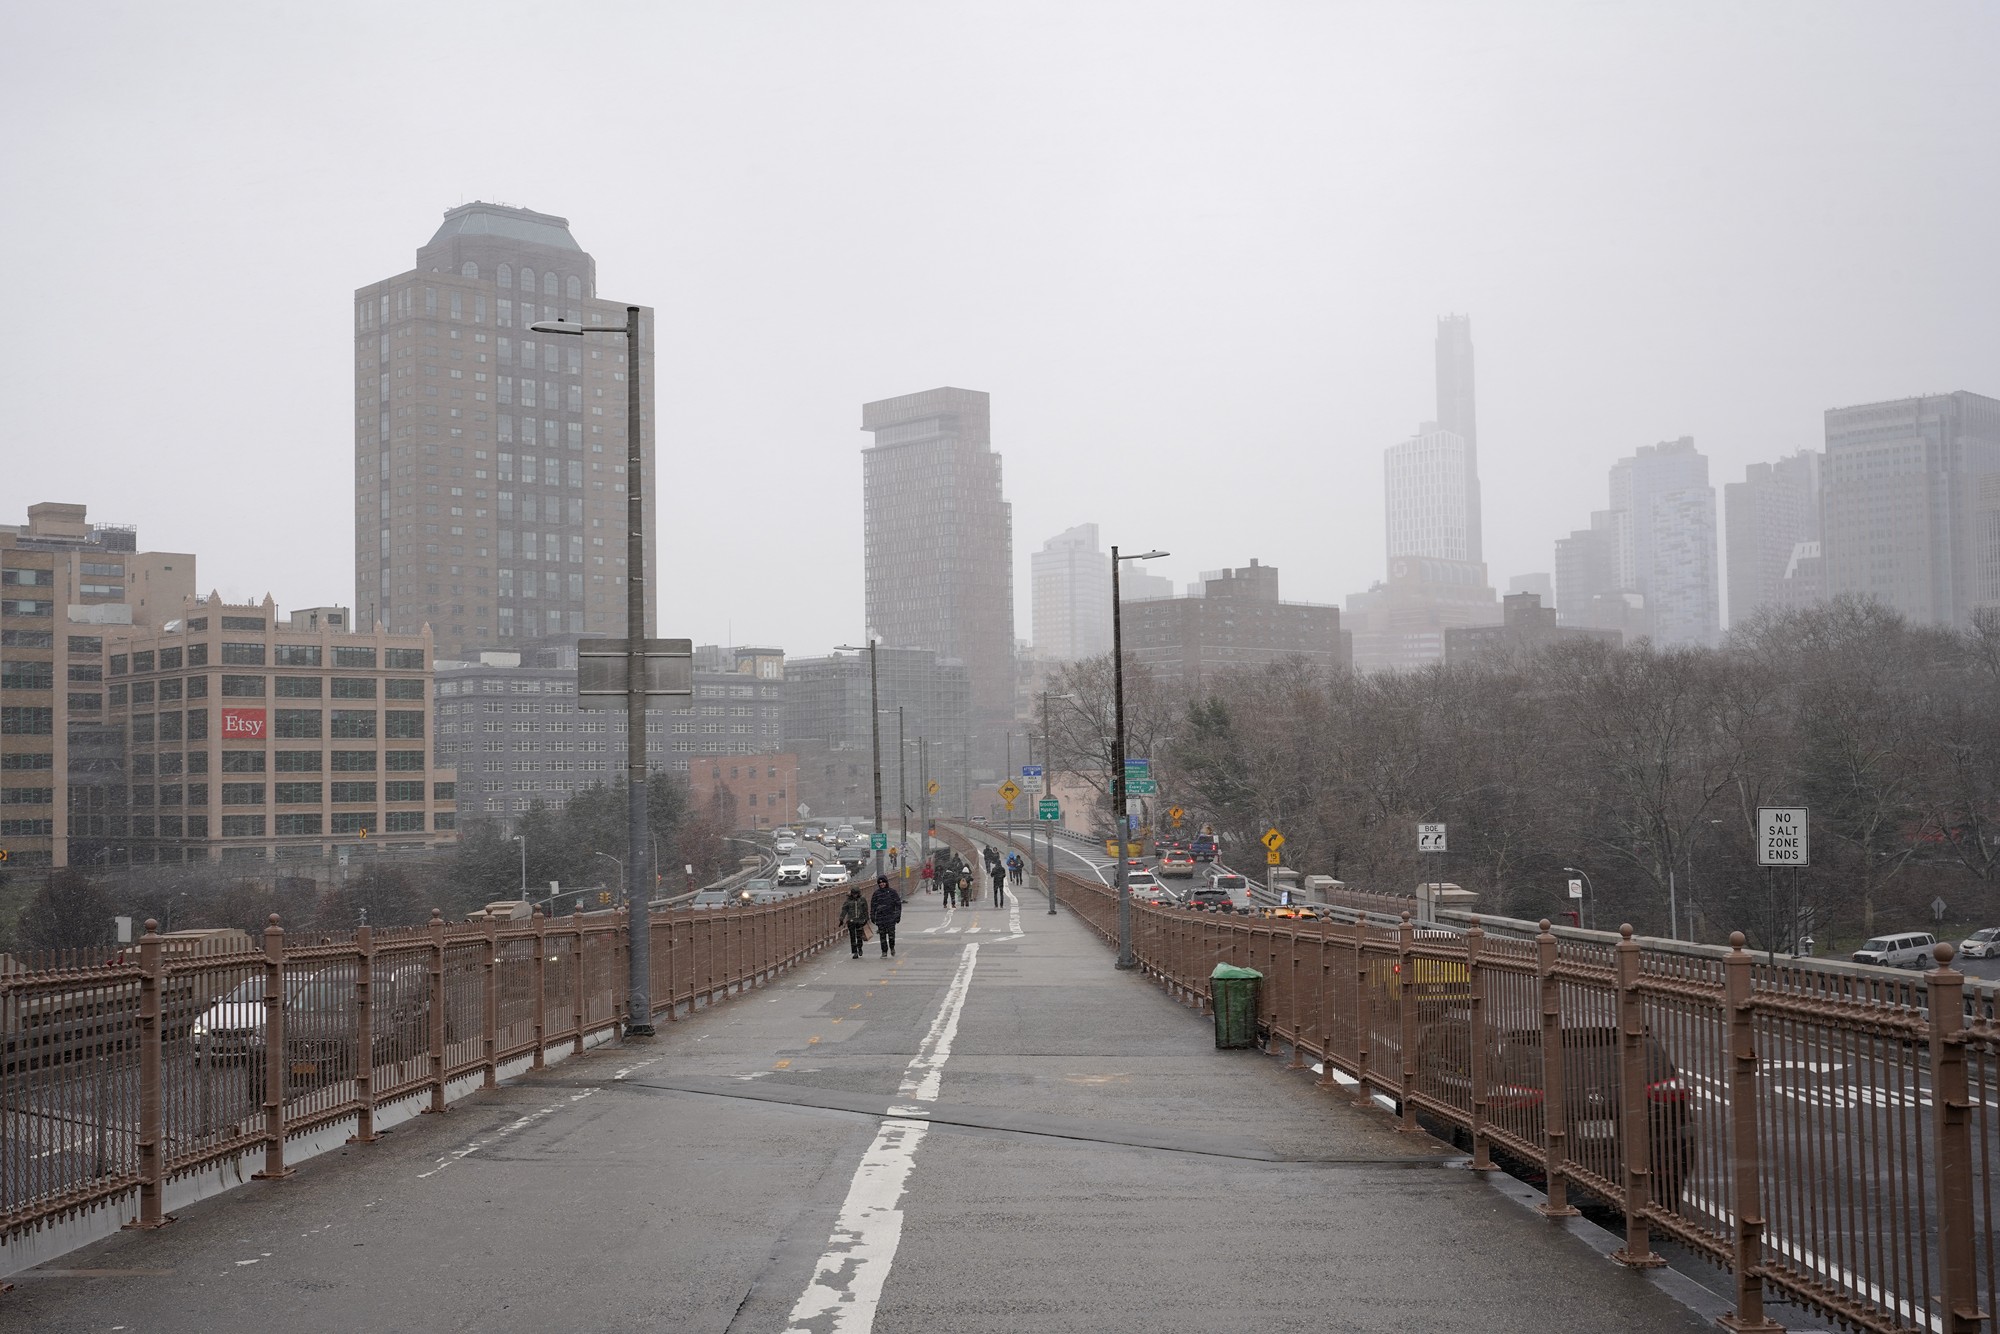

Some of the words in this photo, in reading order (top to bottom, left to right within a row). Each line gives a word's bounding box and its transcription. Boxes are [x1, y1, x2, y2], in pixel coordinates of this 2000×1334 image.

[225, 715, 263, 736] Etsy
[1775, 813, 1791, 823] NO
[1769, 825, 1798, 836] SALT
[1768, 837, 1799, 848] ZONE
[1768, 850, 1799, 860] ENDS
